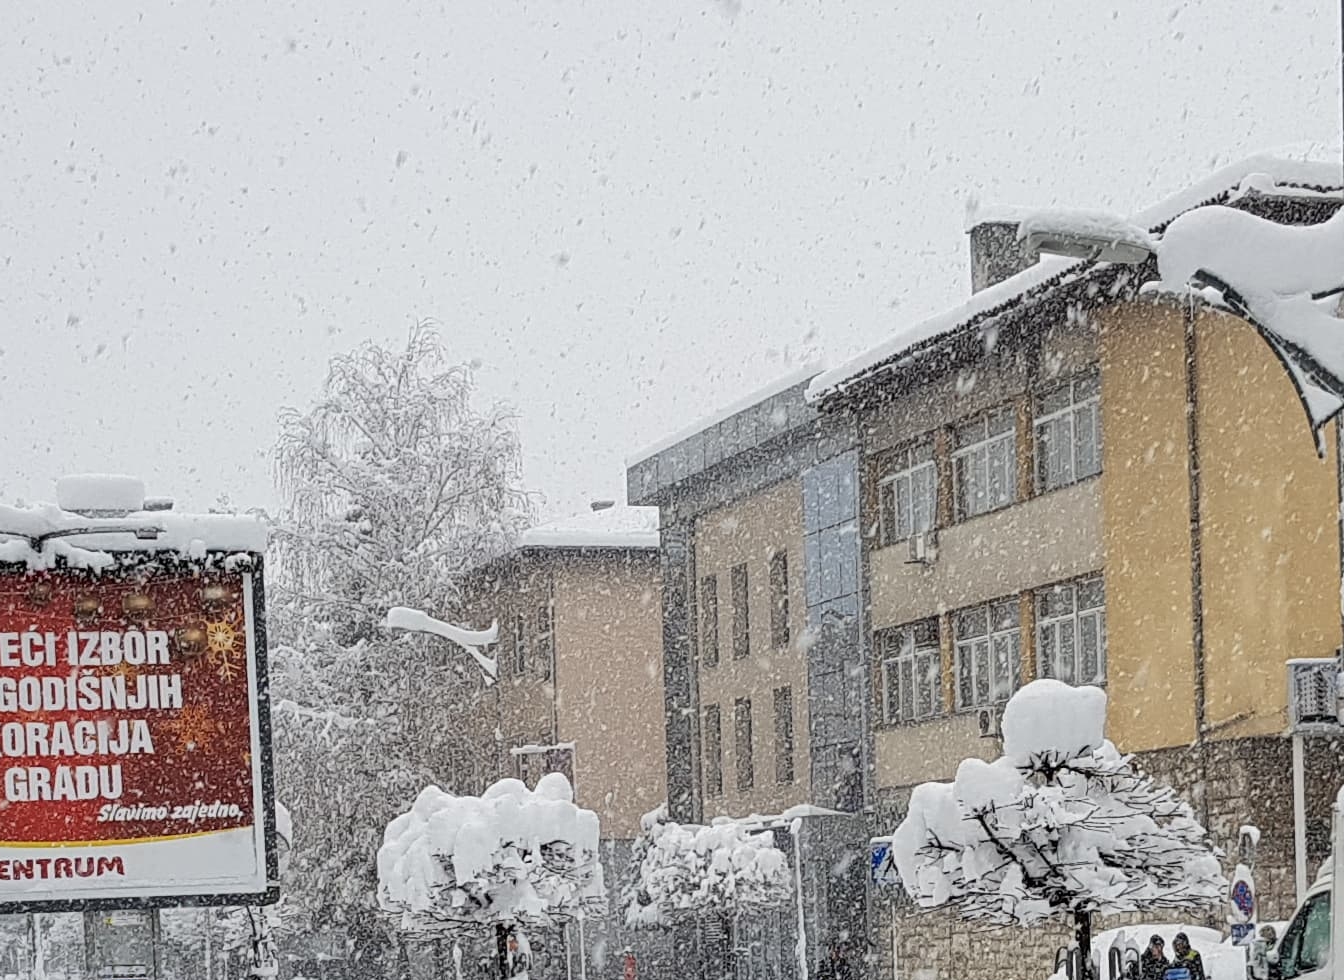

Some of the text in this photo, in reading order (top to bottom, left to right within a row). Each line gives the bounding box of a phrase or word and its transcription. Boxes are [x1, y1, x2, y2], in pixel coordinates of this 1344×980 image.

[67, 629, 171, 667] IZBOR
[5, 764, 124, 802] GRADU
[96, 803, 168, 823] Slavimo
